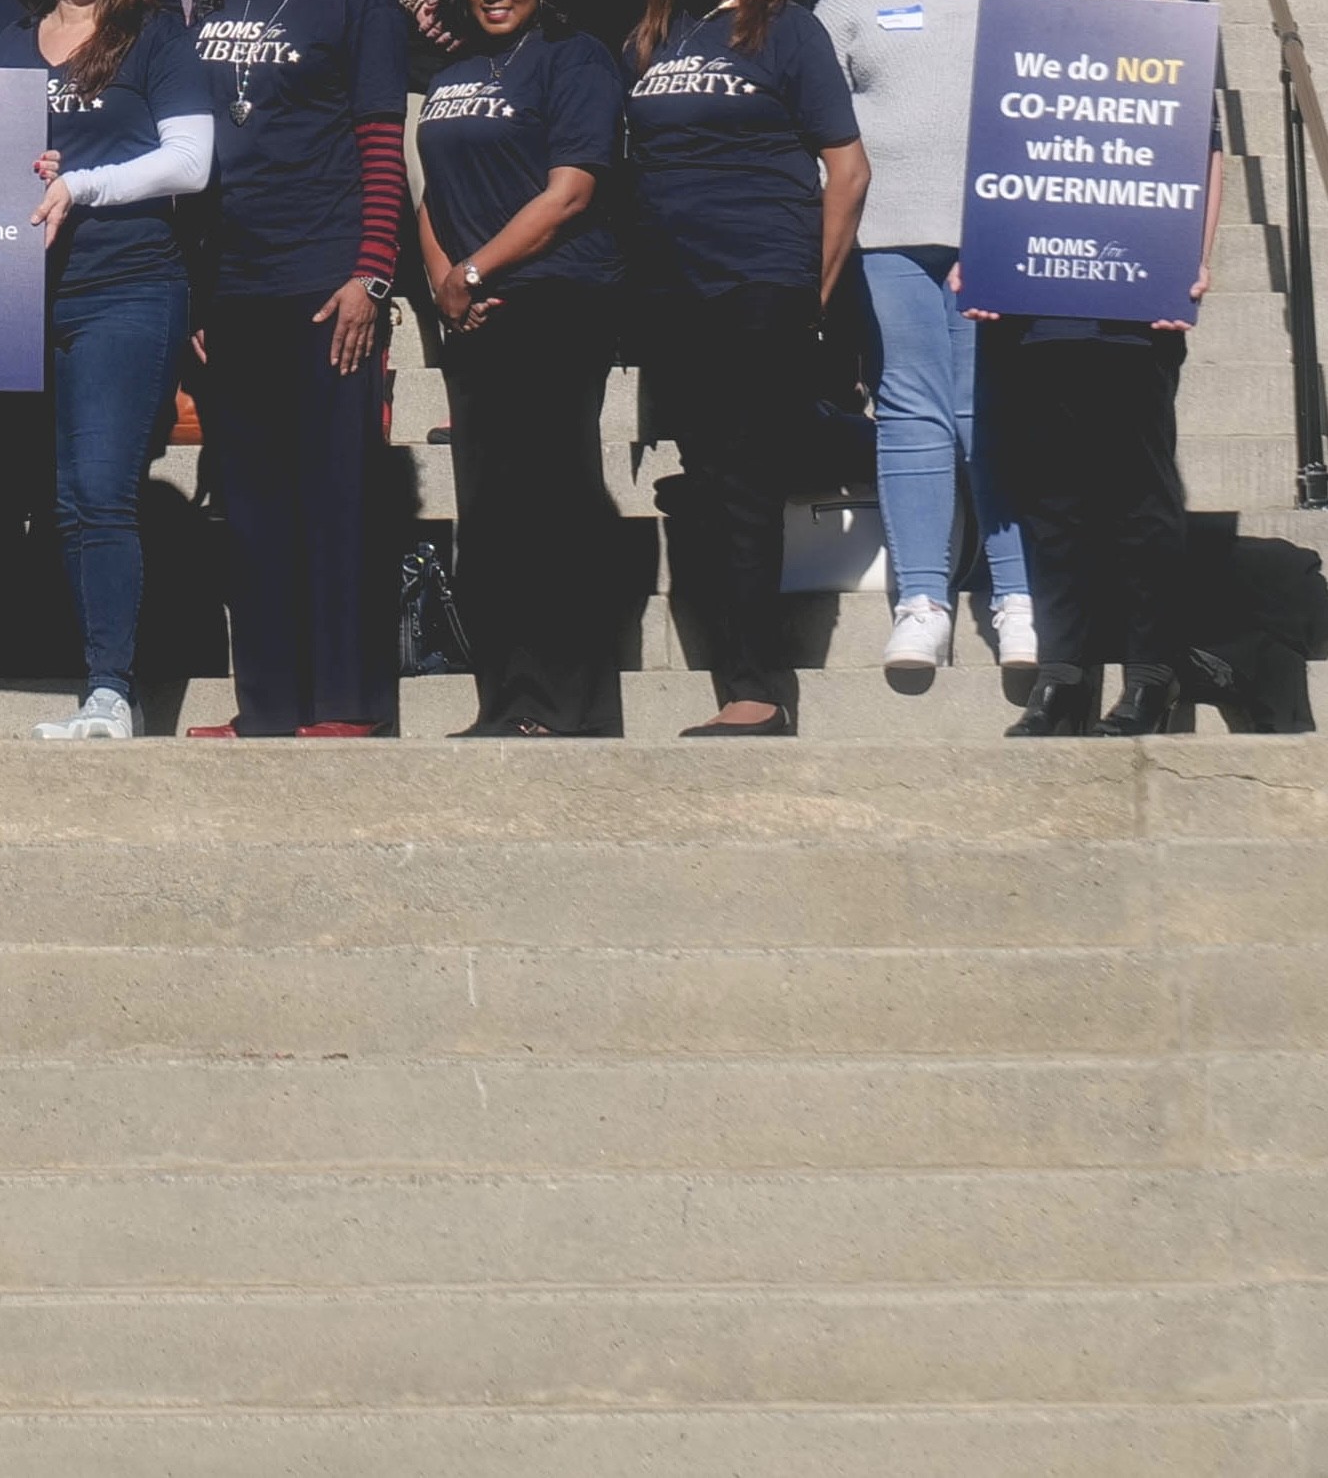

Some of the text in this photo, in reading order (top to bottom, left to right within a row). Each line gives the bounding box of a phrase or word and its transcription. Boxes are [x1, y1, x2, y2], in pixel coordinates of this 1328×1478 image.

[198, 21, 287, 44] MOMS for
[195, 40, 291, 64] LIBERTY
[644, 56, 733, 78] MOMS for
[1014, 52, 1183, 84] We do NOT
[429, 82, 502, 103] MOMS for
[631, 73, 746, 98] LIBERTY
[418, 96, 506, 124] LIBERTY
[1000, 92, 1180, 126] CO-PARENT
[1026, 135, 1154, 166] with the
[975, 173, 1201, 210] GOVERNMENT
[1027, 236, 1128, 260] MOMS for
[1027, 257, 1141, 282] LIBERTY
